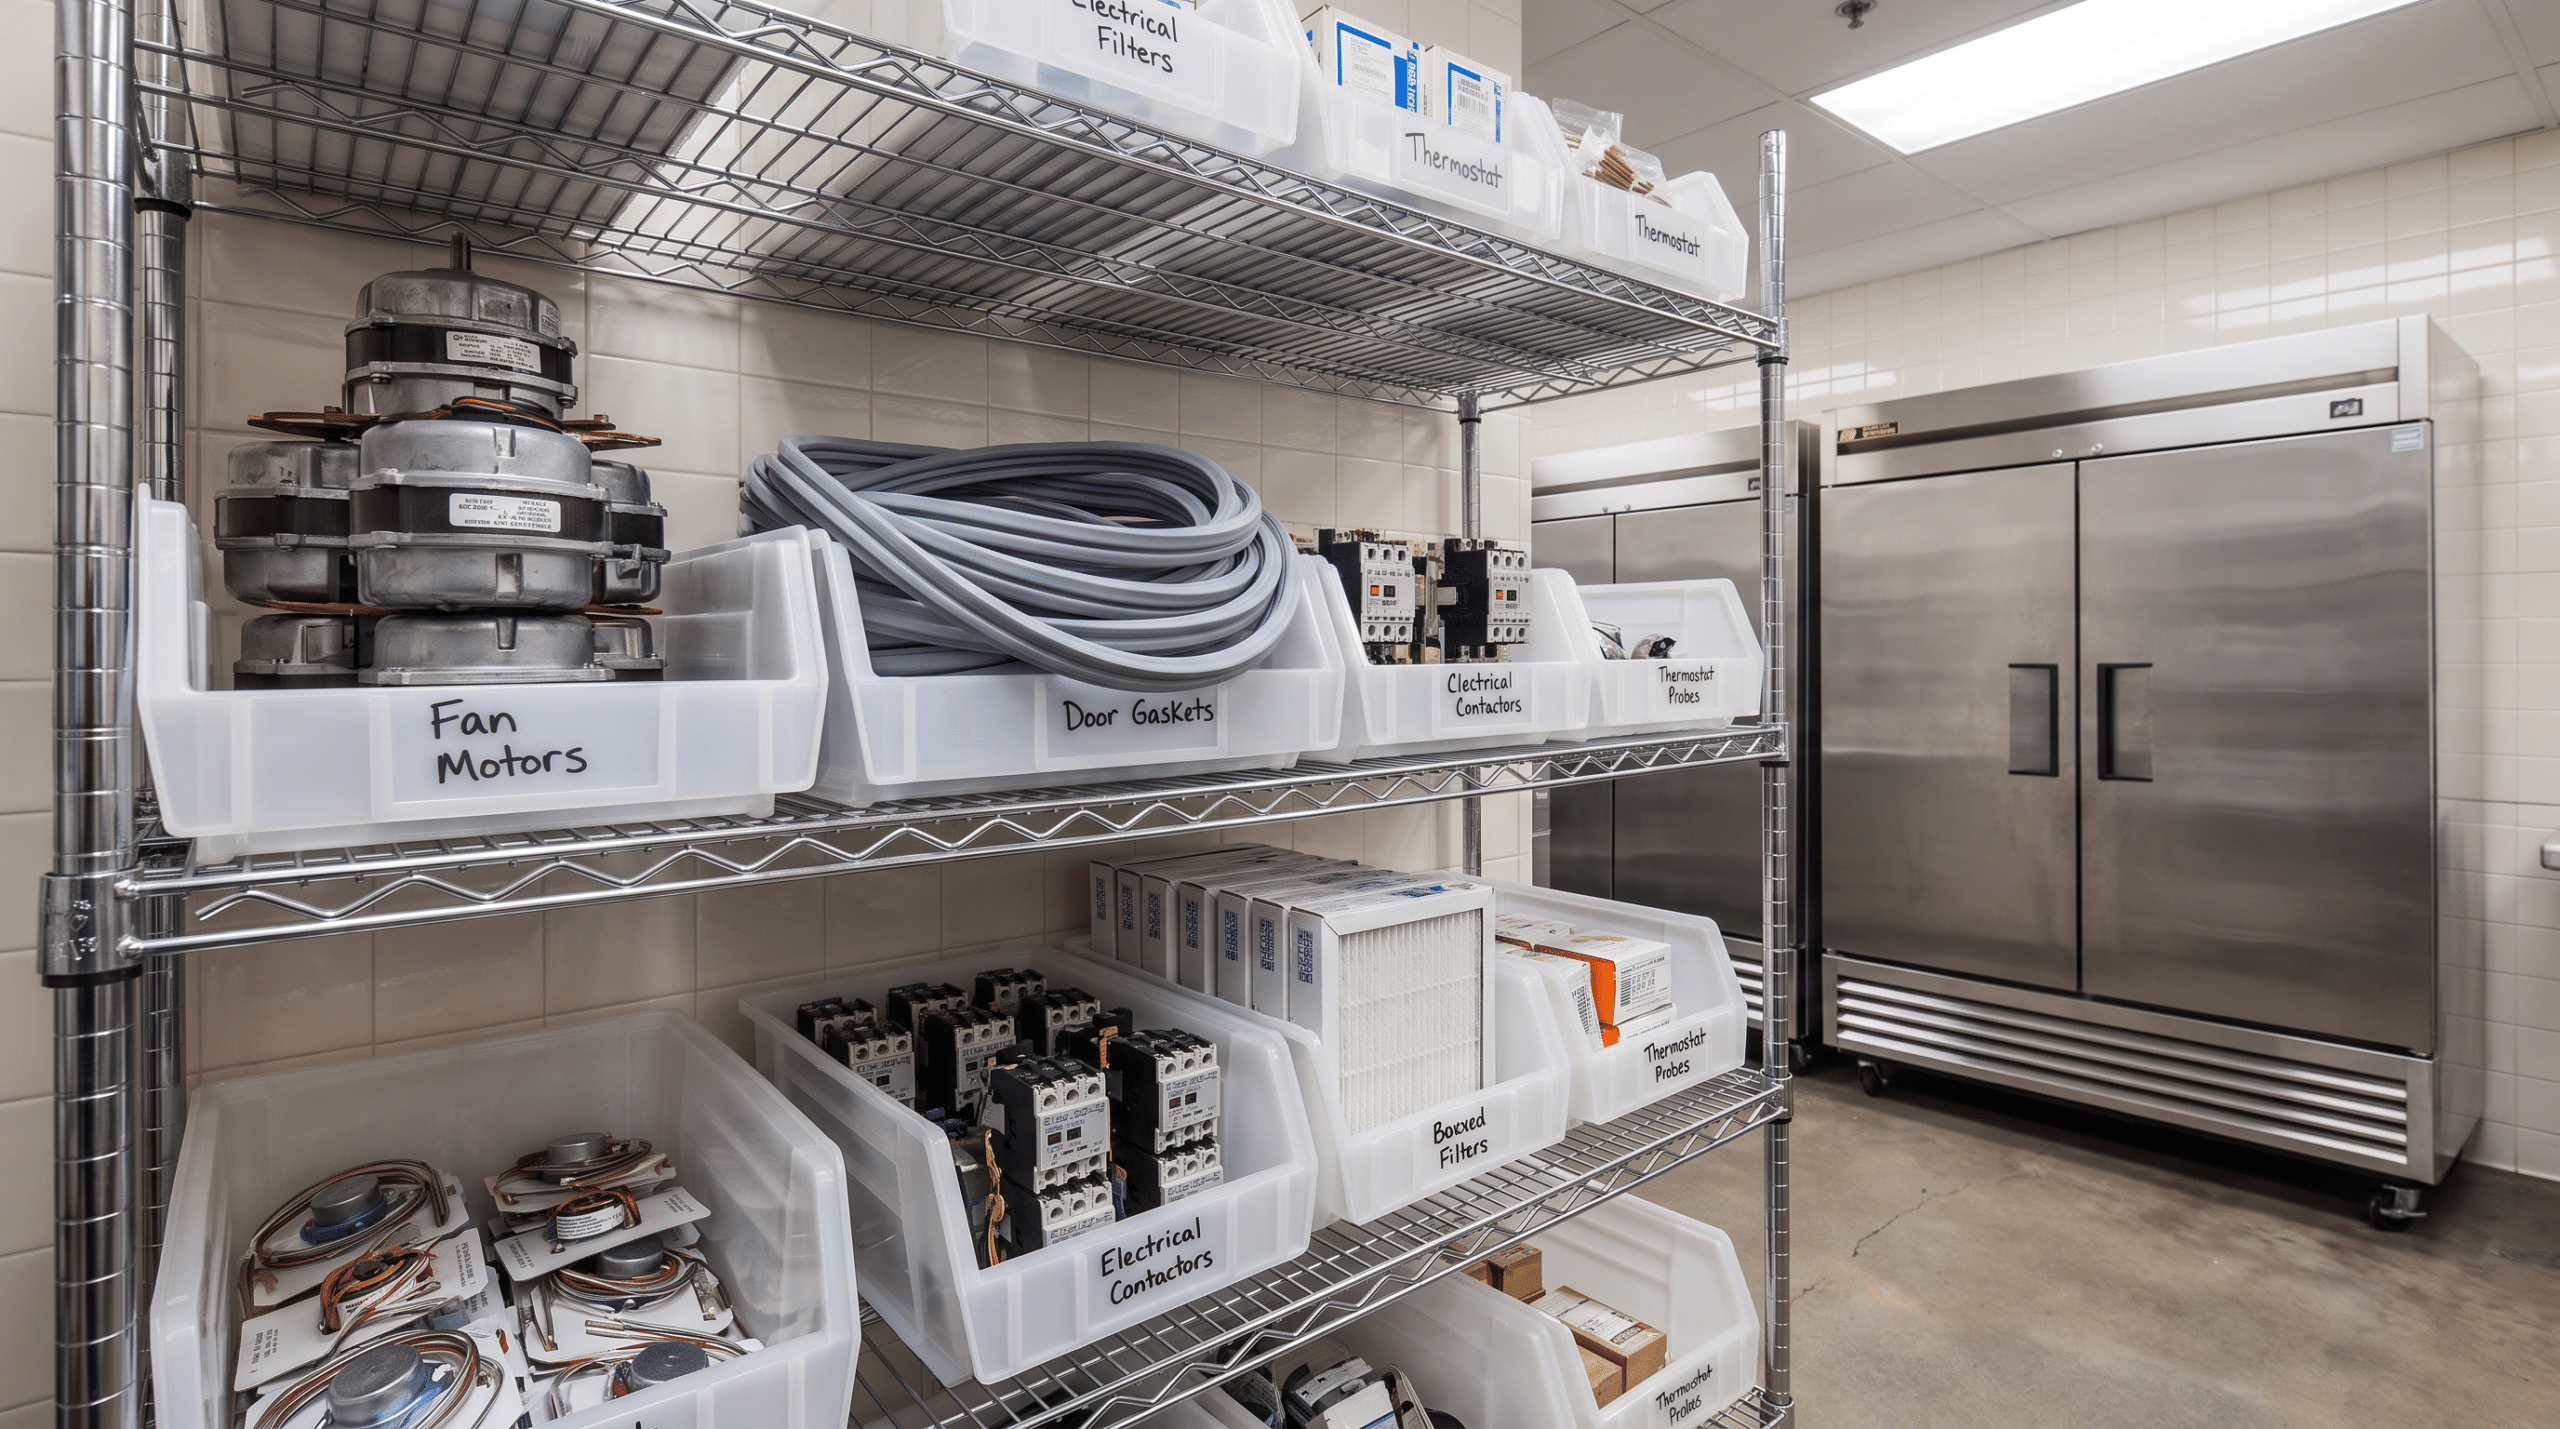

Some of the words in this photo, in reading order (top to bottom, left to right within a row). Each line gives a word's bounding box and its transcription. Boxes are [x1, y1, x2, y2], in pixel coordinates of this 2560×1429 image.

[1098, 26, 1173, 73] Filters
[1405, 133, 1502, 188] Thermostat
[1635, 215, 1700, 257] Thermostat
[1063, 701, 1118, 730] Door
[1132, 698, 1213, 725] Gaskets
[1456, 696, 1521, 717] Contactors
[1669, 686, 1700, 704] Probes
[431, 699, 516, 739] Fan
[438, 745, 587, 784] Motors
[1644, 1027, 1706, 1063] Thermostat
[1656, 1060, 1689, 1083] Probes
[1440, 1139, 1488, 1169] Filters
[1101, 1217, 1200, 1277] Electrical
[1111, 1251, 1213, 1304] Contactors
